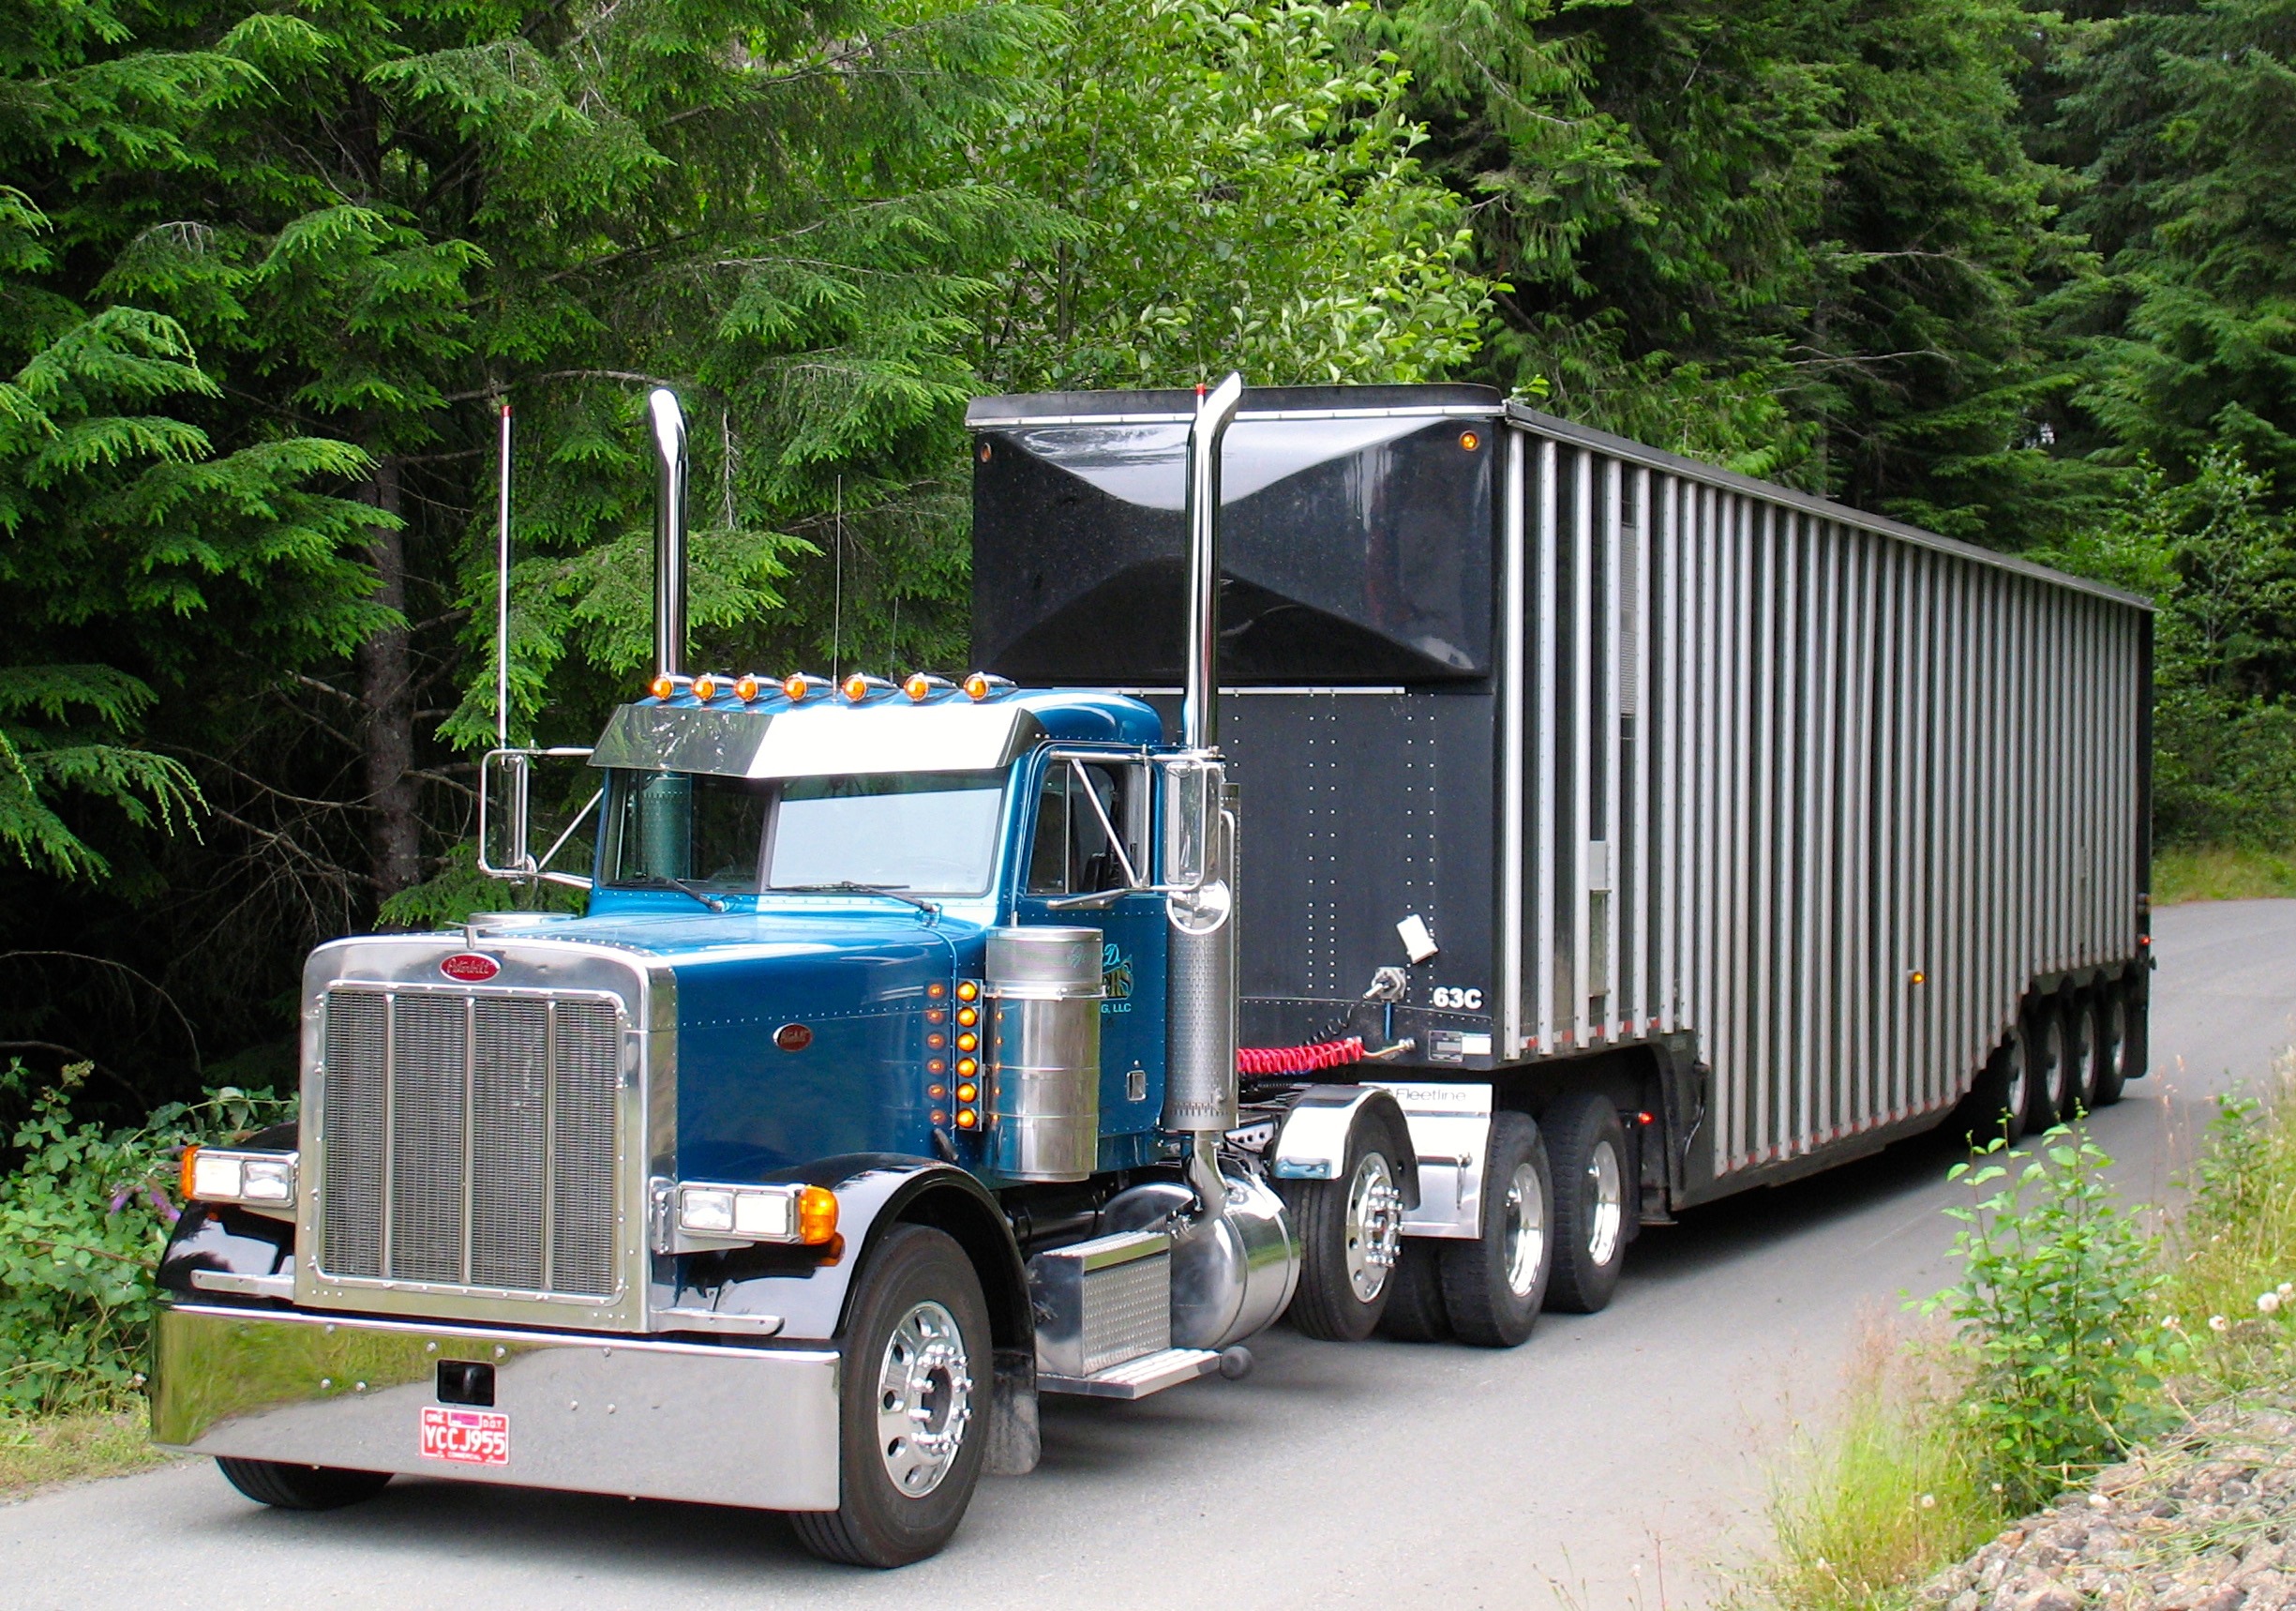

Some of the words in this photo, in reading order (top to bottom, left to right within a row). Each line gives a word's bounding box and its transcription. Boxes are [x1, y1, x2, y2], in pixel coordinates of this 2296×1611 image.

[1433, 986, 1483, 1009] 63C
[1113, 1002, 1132, 1013] LLC
[1395, 1088, 1466, 1102] Fleetline
[425, 1424, 505, 1455] YCCJ955
